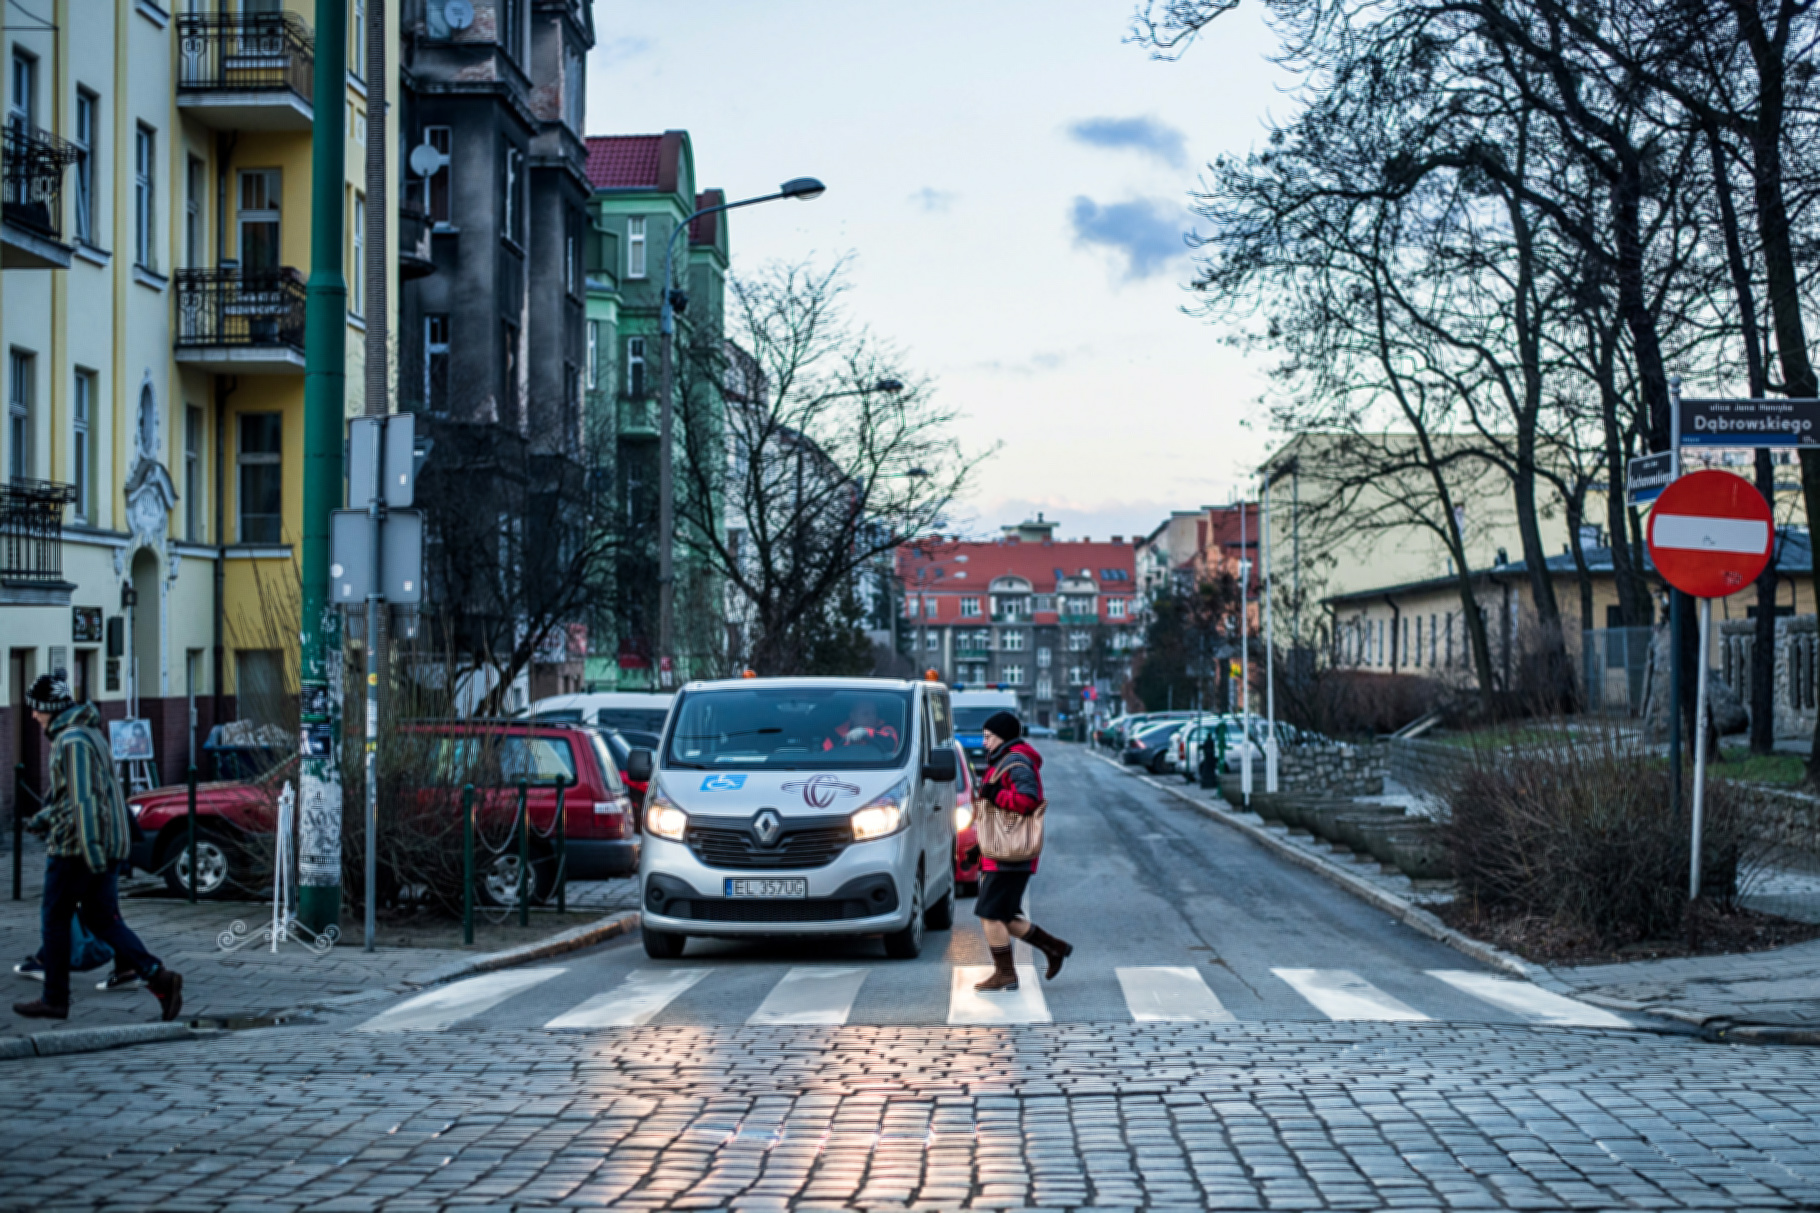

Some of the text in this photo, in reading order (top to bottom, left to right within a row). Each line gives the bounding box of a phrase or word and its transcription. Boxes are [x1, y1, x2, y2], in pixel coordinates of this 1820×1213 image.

[1694, 415, 1813, 434] Dąbrowskiego
[735, 881, 804, 895] EL 357UG
